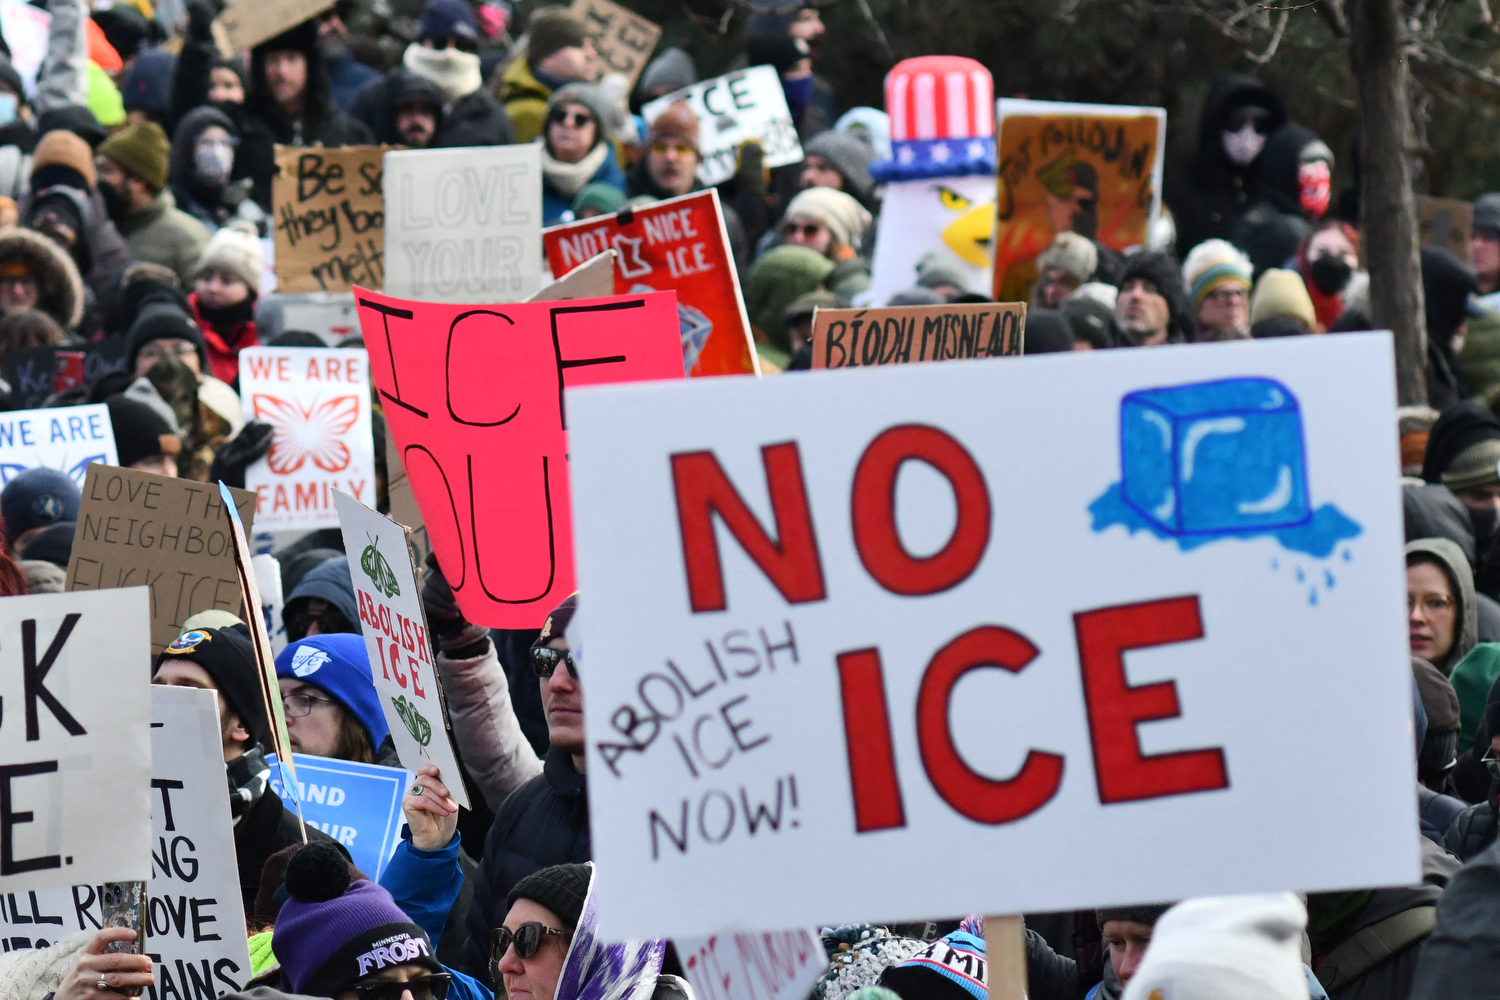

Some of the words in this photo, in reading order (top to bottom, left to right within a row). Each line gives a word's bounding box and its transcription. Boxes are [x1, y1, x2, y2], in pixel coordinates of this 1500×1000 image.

[703, 76, 756, 116] CE
[298, 154, 346, 203] Be
[401, 163, 532, 231] LOVE
[558, 226, 610, 267] NOT
[642, 208, 698, 246] NICE
[402, 235, 525, 298] YOUR
[248, 356, 291, 382] WE
[306, 356, 360, 383] ARE
[50, 414, 104, 443] ARE
[91, 473, 163, 510] LOVE
[255, 478, 365, 514] FAMIY
[670, 422, 993, 614] NO
[404, 443, 569, 604] OU
[357, 589, 431, 664] ABOLISH
[376, 636, 427, 700] ICE
[596, 619, 801, 780] ABOLISH
[835, 593, 1232, 835] ICE
[673, 693, 772, 779] ICE
[649, 772, 802, 861] NOW!
[72, 884, 222, 942] ROVE
[371, 932, 411, 950] MINNESOTA
[356, 937, 430, 977] FROST
